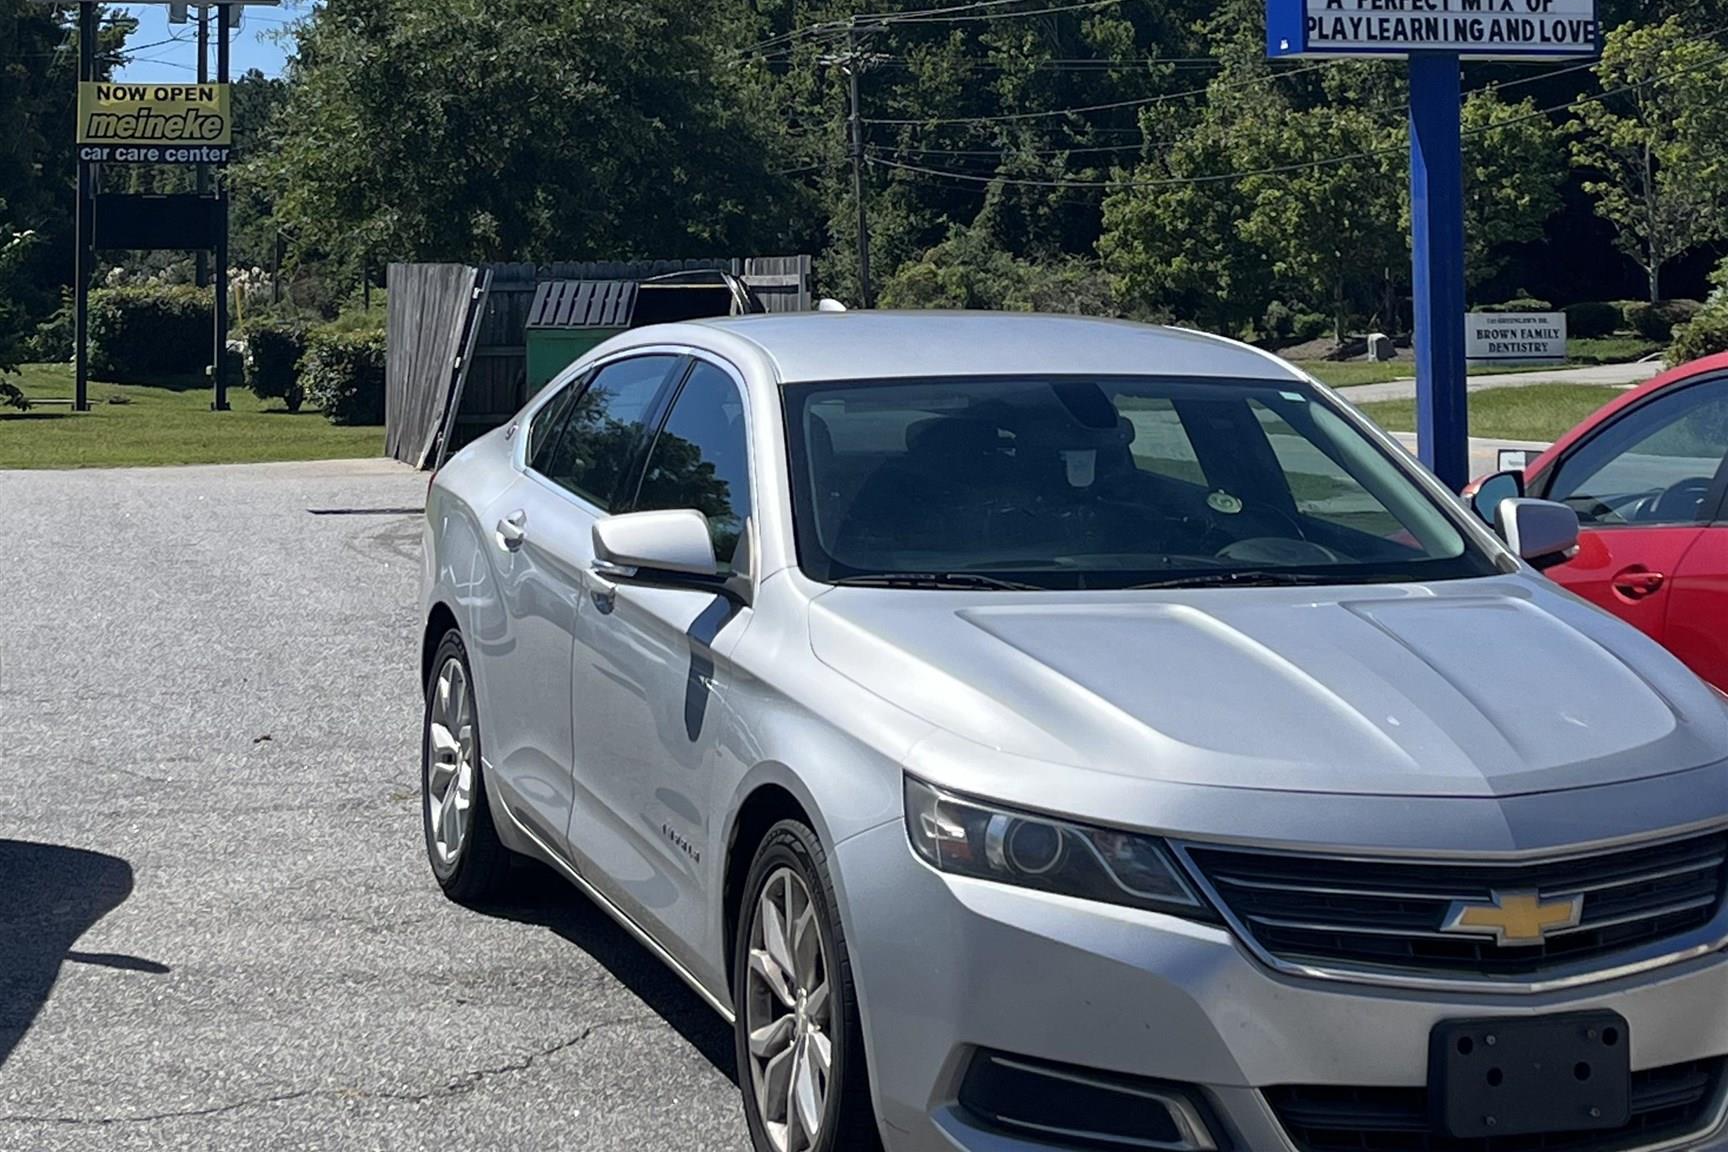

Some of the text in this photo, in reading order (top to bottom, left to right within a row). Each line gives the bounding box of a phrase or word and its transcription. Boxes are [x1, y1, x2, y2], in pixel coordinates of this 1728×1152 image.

[96, 86, 214, 103] NOW OPEN
[86, 107, 225, 141] meineke
[80, 146, 230, 163] car care center
[1476, 328, 1561, 340] BROWN FAMILY
[1488, 342, 1549, 353] DENTISTRY
